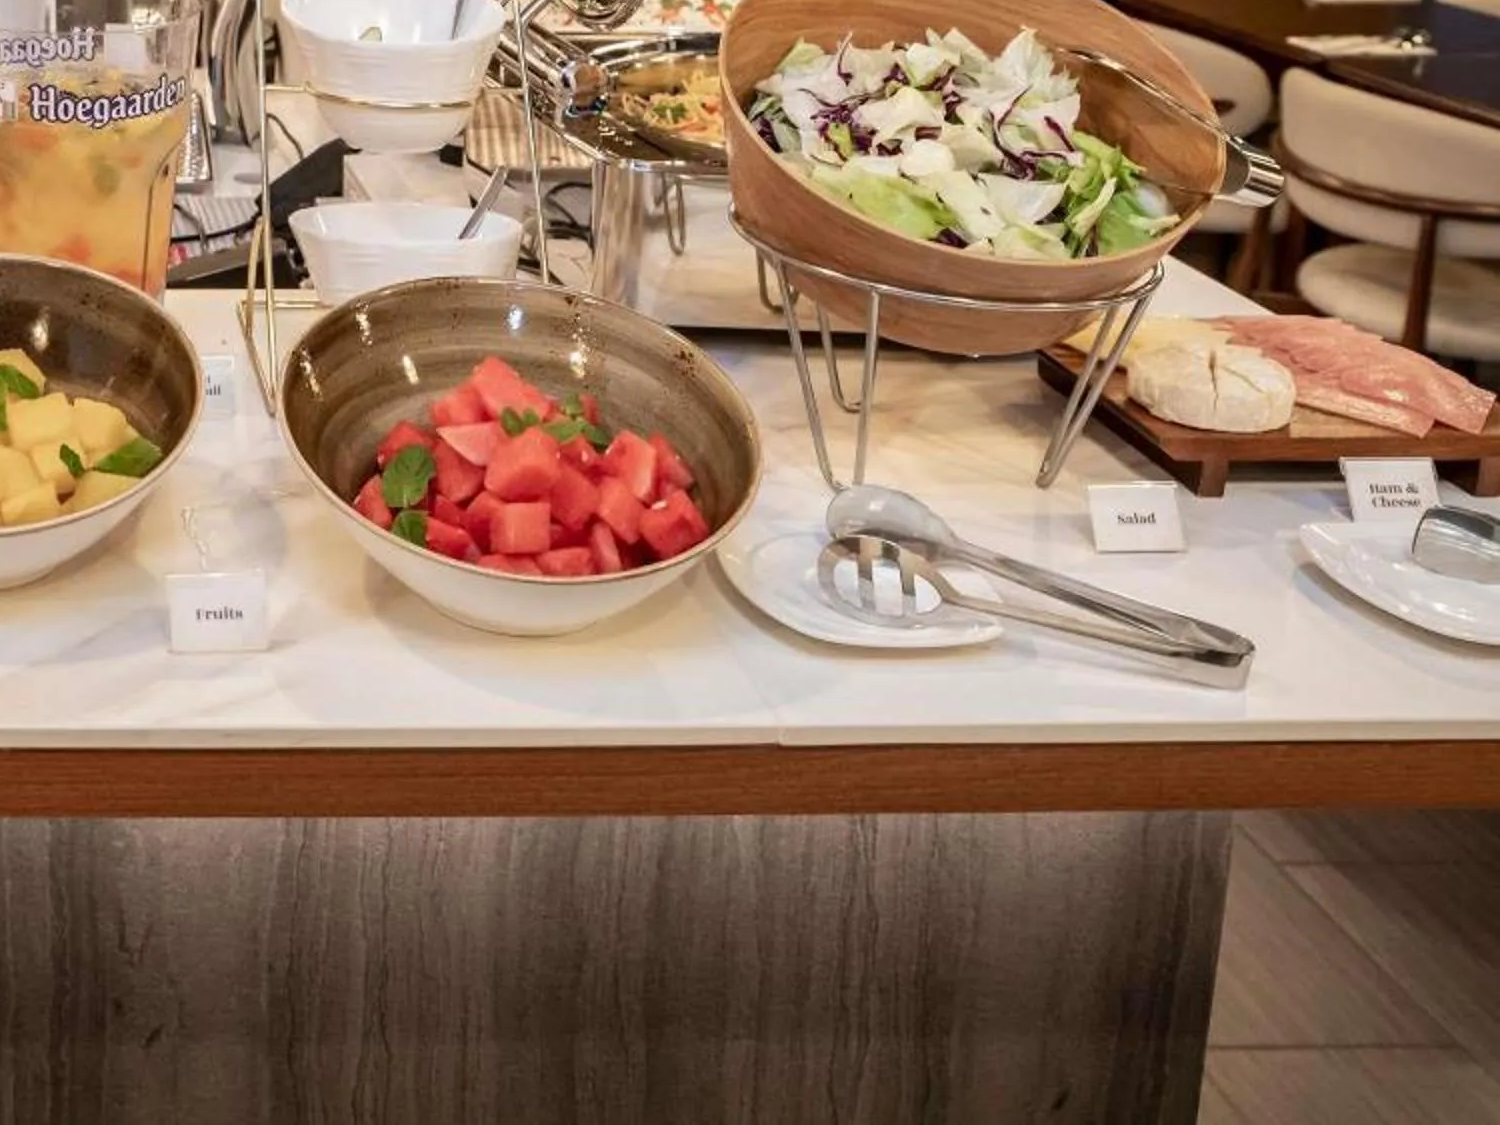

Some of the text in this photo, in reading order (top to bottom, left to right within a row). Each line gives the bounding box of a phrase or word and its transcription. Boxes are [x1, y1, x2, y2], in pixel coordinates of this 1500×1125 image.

[29, 73, 187, 129] Hoegaarden
[1369, 483, 1403, 494] Ham
[1371, 495, 1421, 507] Cheese
[1117, 511, 1156, 524] Salad
[195, 606, 243, 620] Fruits
